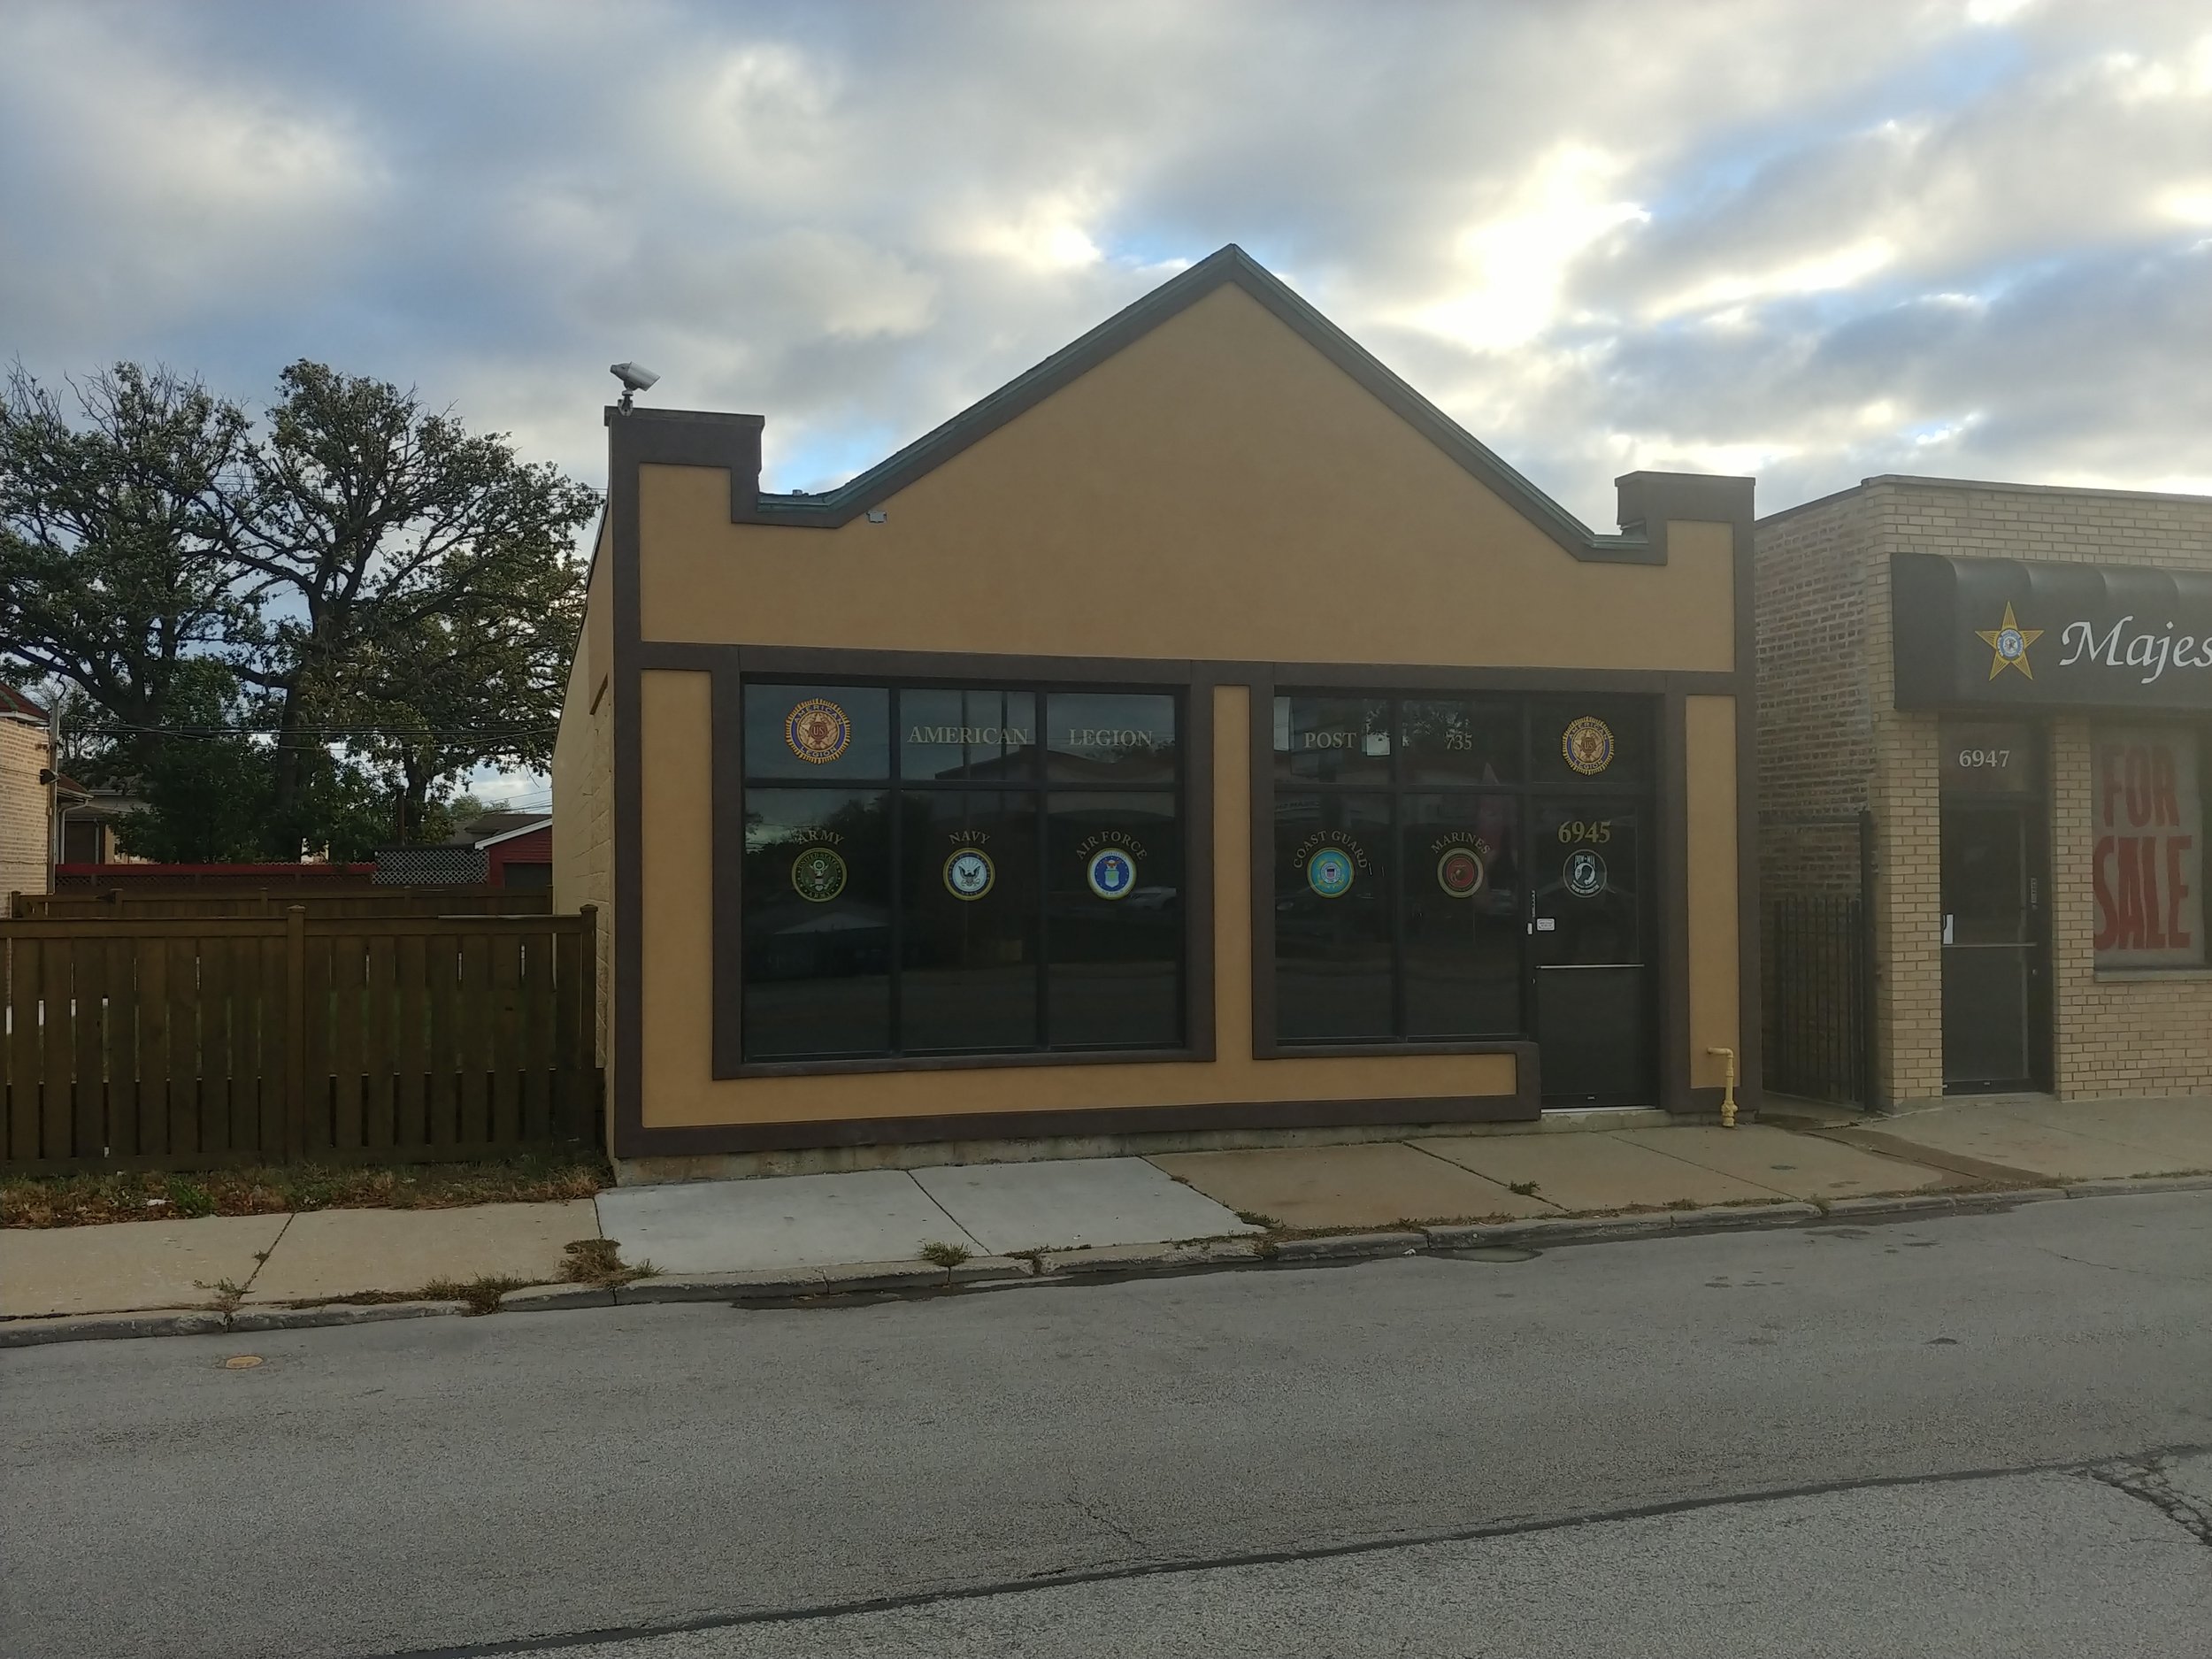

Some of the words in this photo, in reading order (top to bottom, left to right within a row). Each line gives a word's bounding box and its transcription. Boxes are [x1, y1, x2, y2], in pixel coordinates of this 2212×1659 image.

[2059, 615, 2212, 684] Majes
[794, 704, 843, 725] AMERICAN
[813, 726, 824, 736] US
[907, 726, 1029, 744] AMERICAN
[1069, 728, 1154, 748] LEGION
[1304, 731, 1357, 750] POST
[1445, 733, 1473, 751] 735
[1569, 722, 1608, 741] AMERICAN
[800, 746, 837, 757] LEGION
[1958, 749, 2011, 769] 6947
[1573, 759, 1603, 769] LEGION
[2101, 743, 2179, 829] FOR
[798, 829, 845, 846] ARMY
[949, 830, 991, 844] NAVY
[1557, 820, 1611, 843] 6945
[1076, 835, 1099, 860] AIR
[1101, 830, 1148, 860] FORCE
[1293, 830, 1327, 868] COAST
[1332, 830, 1368, 868] GUARD
[1430, 832, 1491, 854] MARINES
[2092, 834, 2193, 951] SALE
